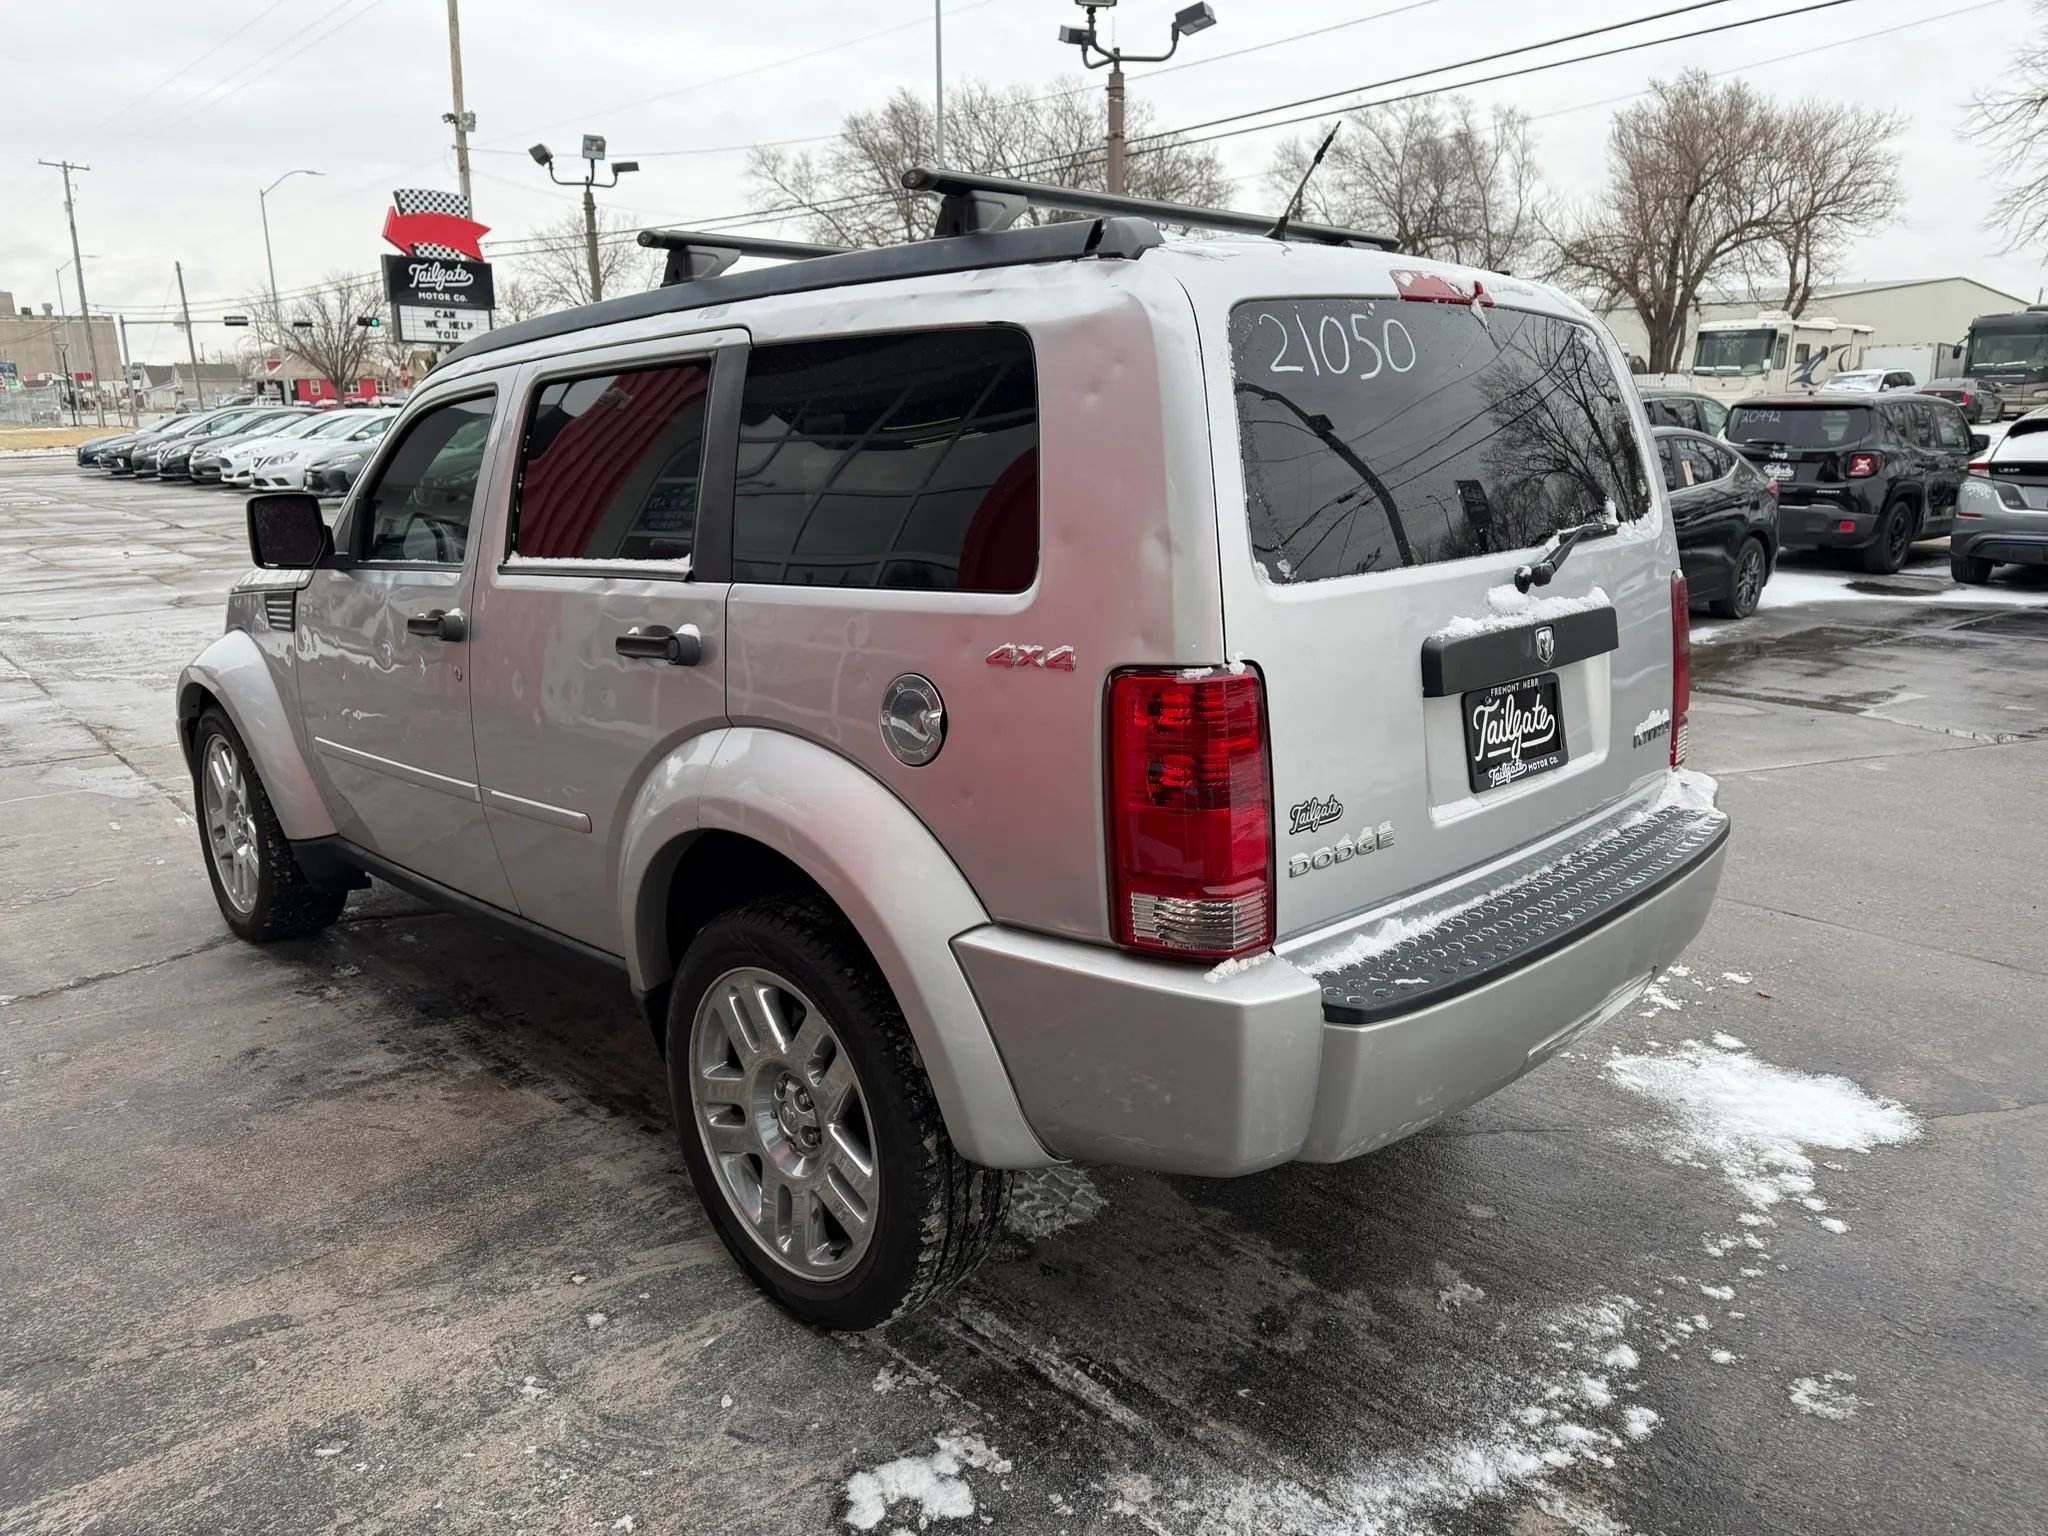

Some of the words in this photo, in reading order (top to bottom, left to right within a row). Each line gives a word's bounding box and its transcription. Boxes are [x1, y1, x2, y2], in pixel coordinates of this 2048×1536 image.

[409, 261, 474, 291] Tailgate
[418, 291, 451, 302] MOTOR
[434, 309, 456, 319] CAN
[424, 319, 439, 329] WE
[448, 320, 474, 331] HELP
[436, 330, 459, 340] YOU
[1258, 312, 1416, 380] 21050
[1741, 409, 1781, 423] 20992
[1490, 682, 1520, 697] FREMONT
[1522, 677, 1539, 689] NEBR
[1473, 693, 1556, 762] Tailgate
[1488, 758, 1528, 788] Tailgate
[1528, 759, 1549, 773] MOTOR
[1289, 794, 1344, 835] Tailgate
[1288, 829, 1395, 879] DODGE
